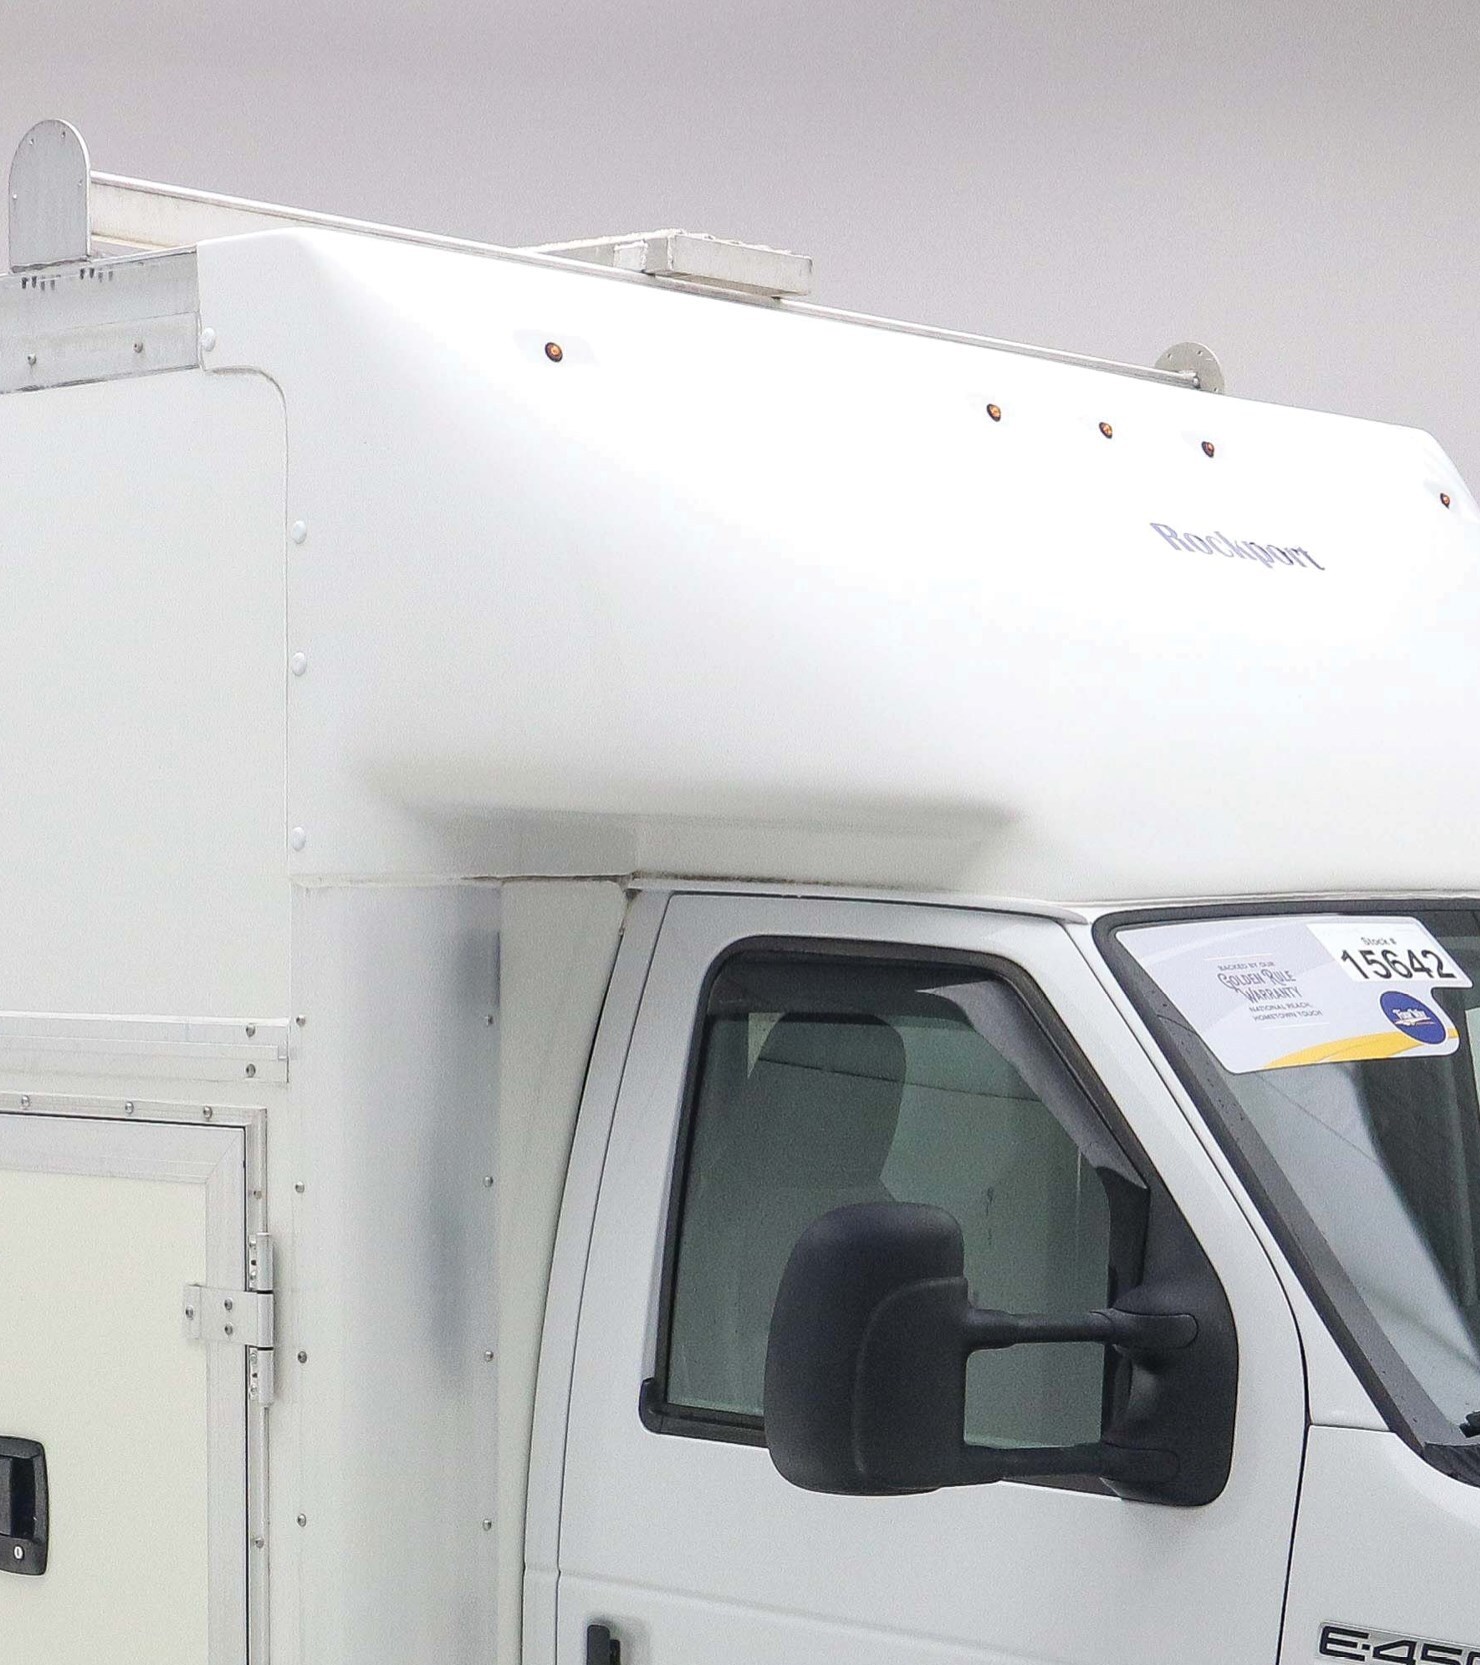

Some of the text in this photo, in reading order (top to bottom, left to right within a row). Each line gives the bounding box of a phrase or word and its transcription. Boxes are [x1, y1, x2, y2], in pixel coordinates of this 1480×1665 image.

[1149, 521, 1326, 571] Rockport
[1340, 949, 1458, 979] 15642
[1217, 968, 1297, 992] GOLDEN RULE
[1236, 985, 1303, 1004] WARRANTY
